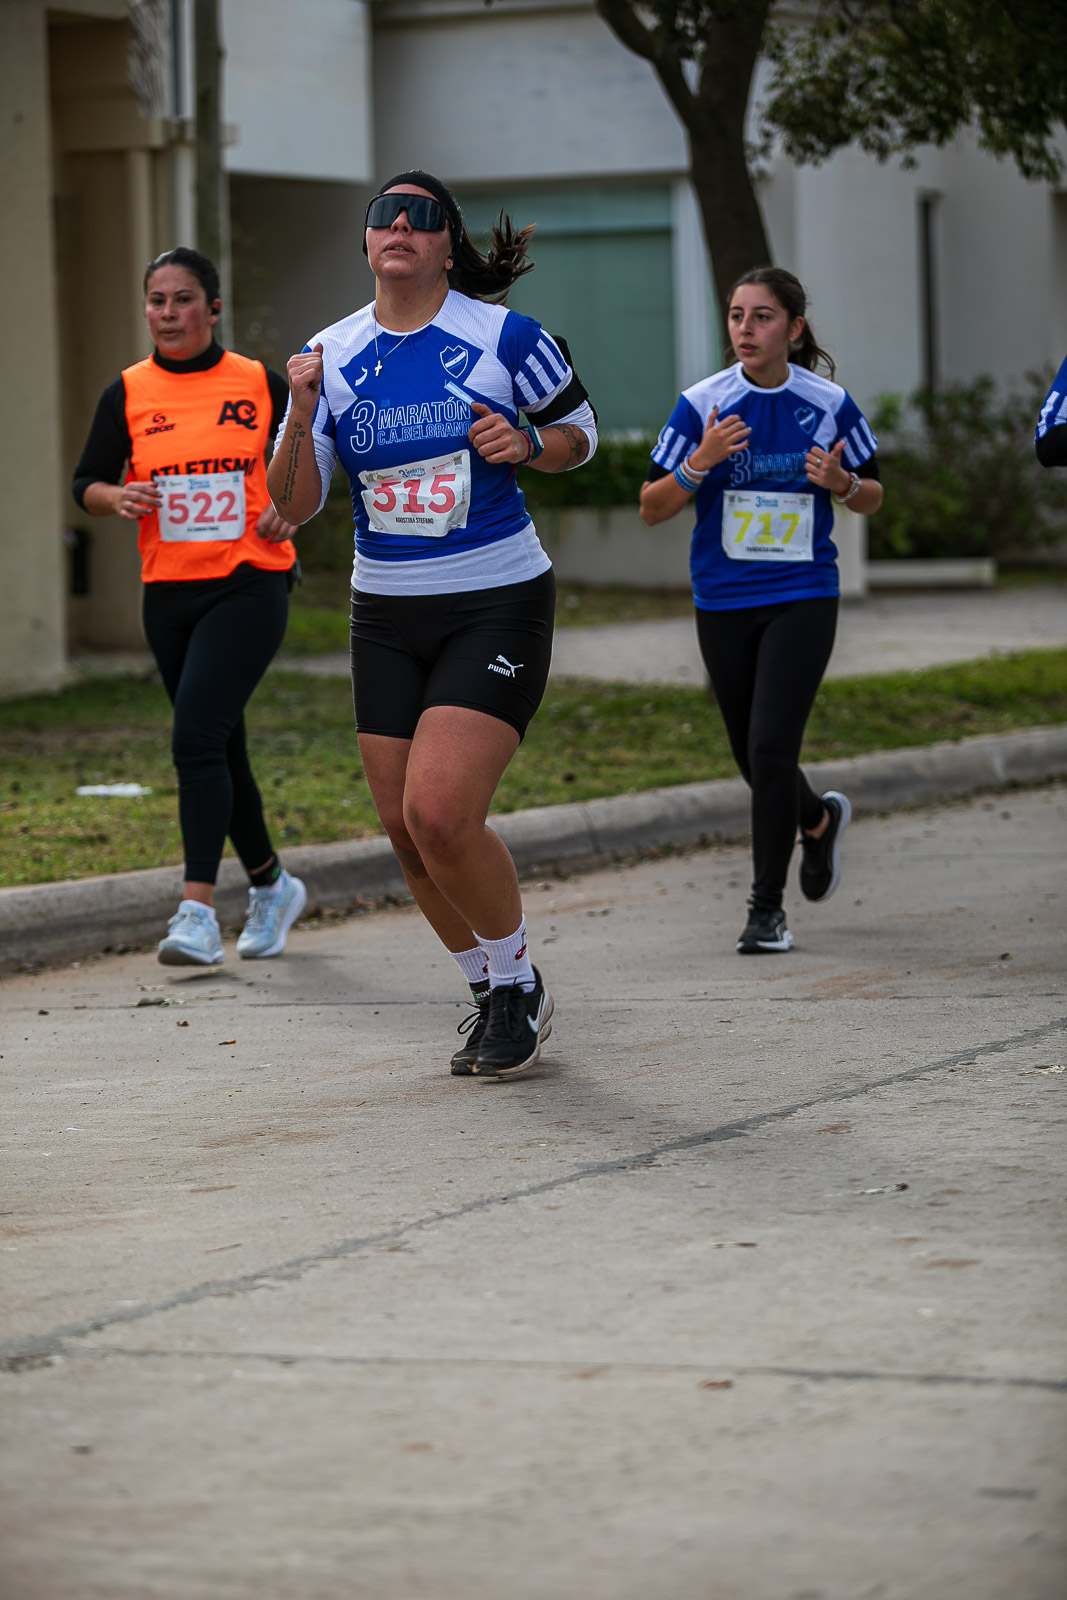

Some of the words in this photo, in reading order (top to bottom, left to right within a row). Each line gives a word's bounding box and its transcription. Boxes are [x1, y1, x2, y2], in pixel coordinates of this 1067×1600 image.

[350, 400, 376, 453] 3
[377, 396, 471, 430] MARATÓN
[168, 491, 239, 524] 522
[372, 474, 456, 513] 515
[733, 511, 800, 545] 717
[487, 663, 511, 677] PUMA
